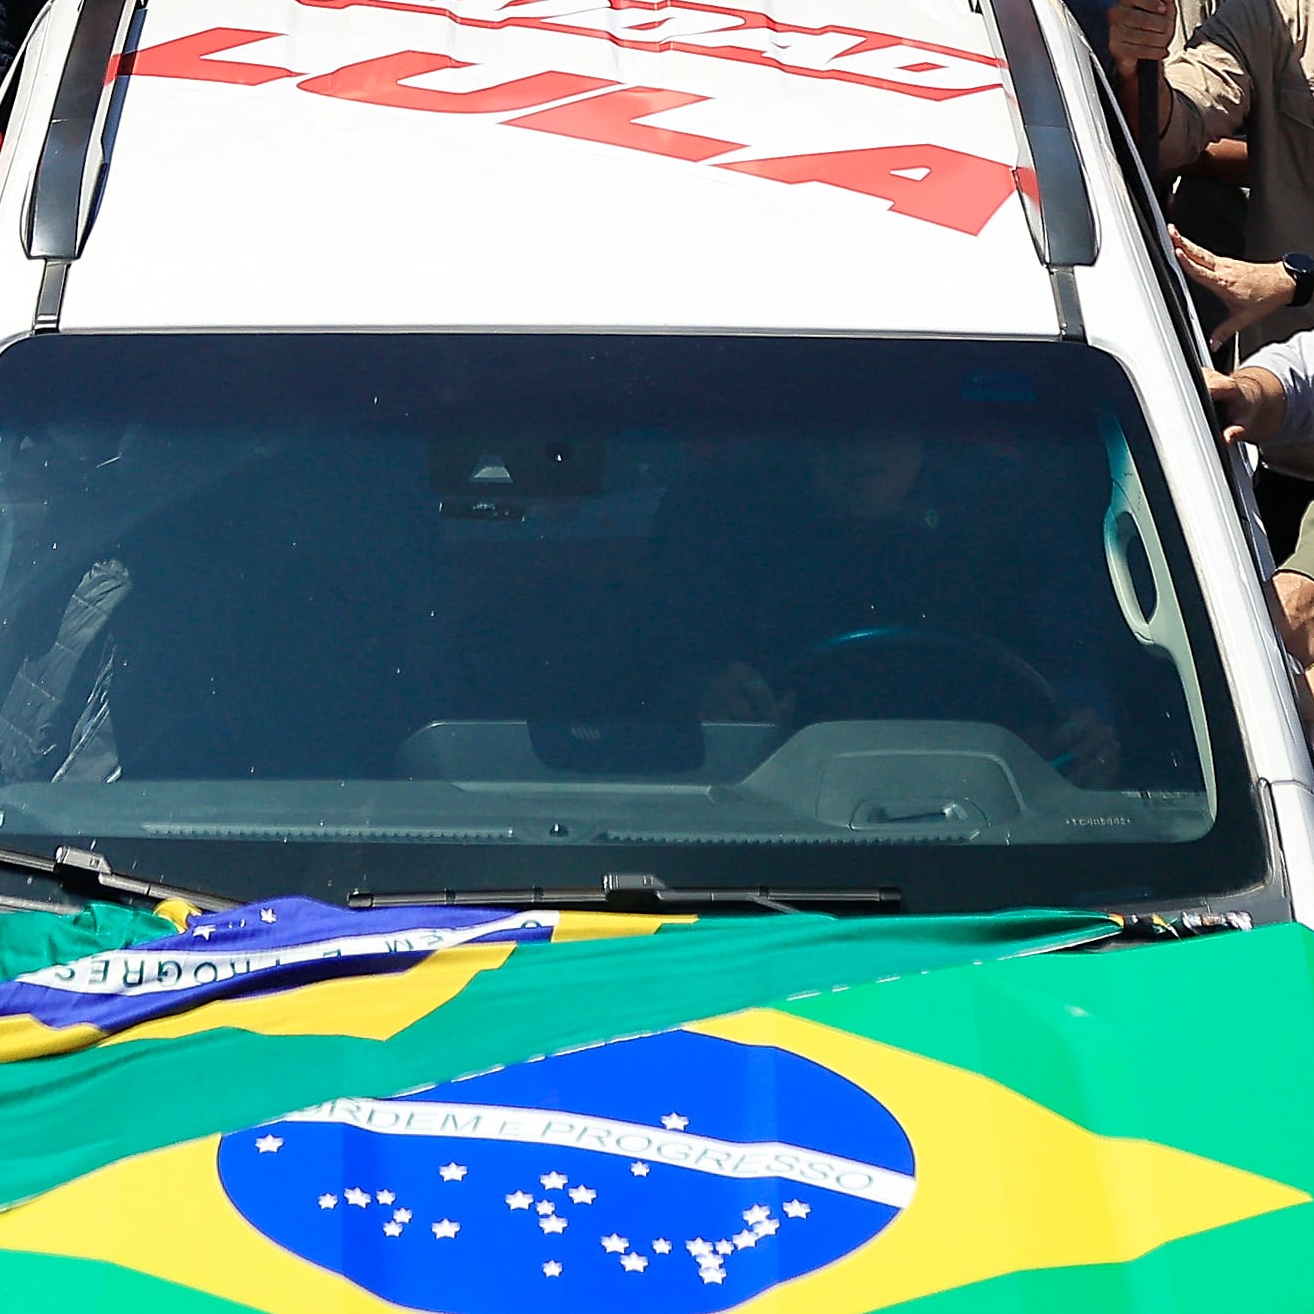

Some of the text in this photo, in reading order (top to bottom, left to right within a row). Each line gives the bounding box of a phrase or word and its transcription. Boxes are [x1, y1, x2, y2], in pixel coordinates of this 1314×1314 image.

[105, 27, 1040, 236] LULA
[498, 1116, 525, 1137] E
[541, 1119, 875, 1191] PROGRESSO
